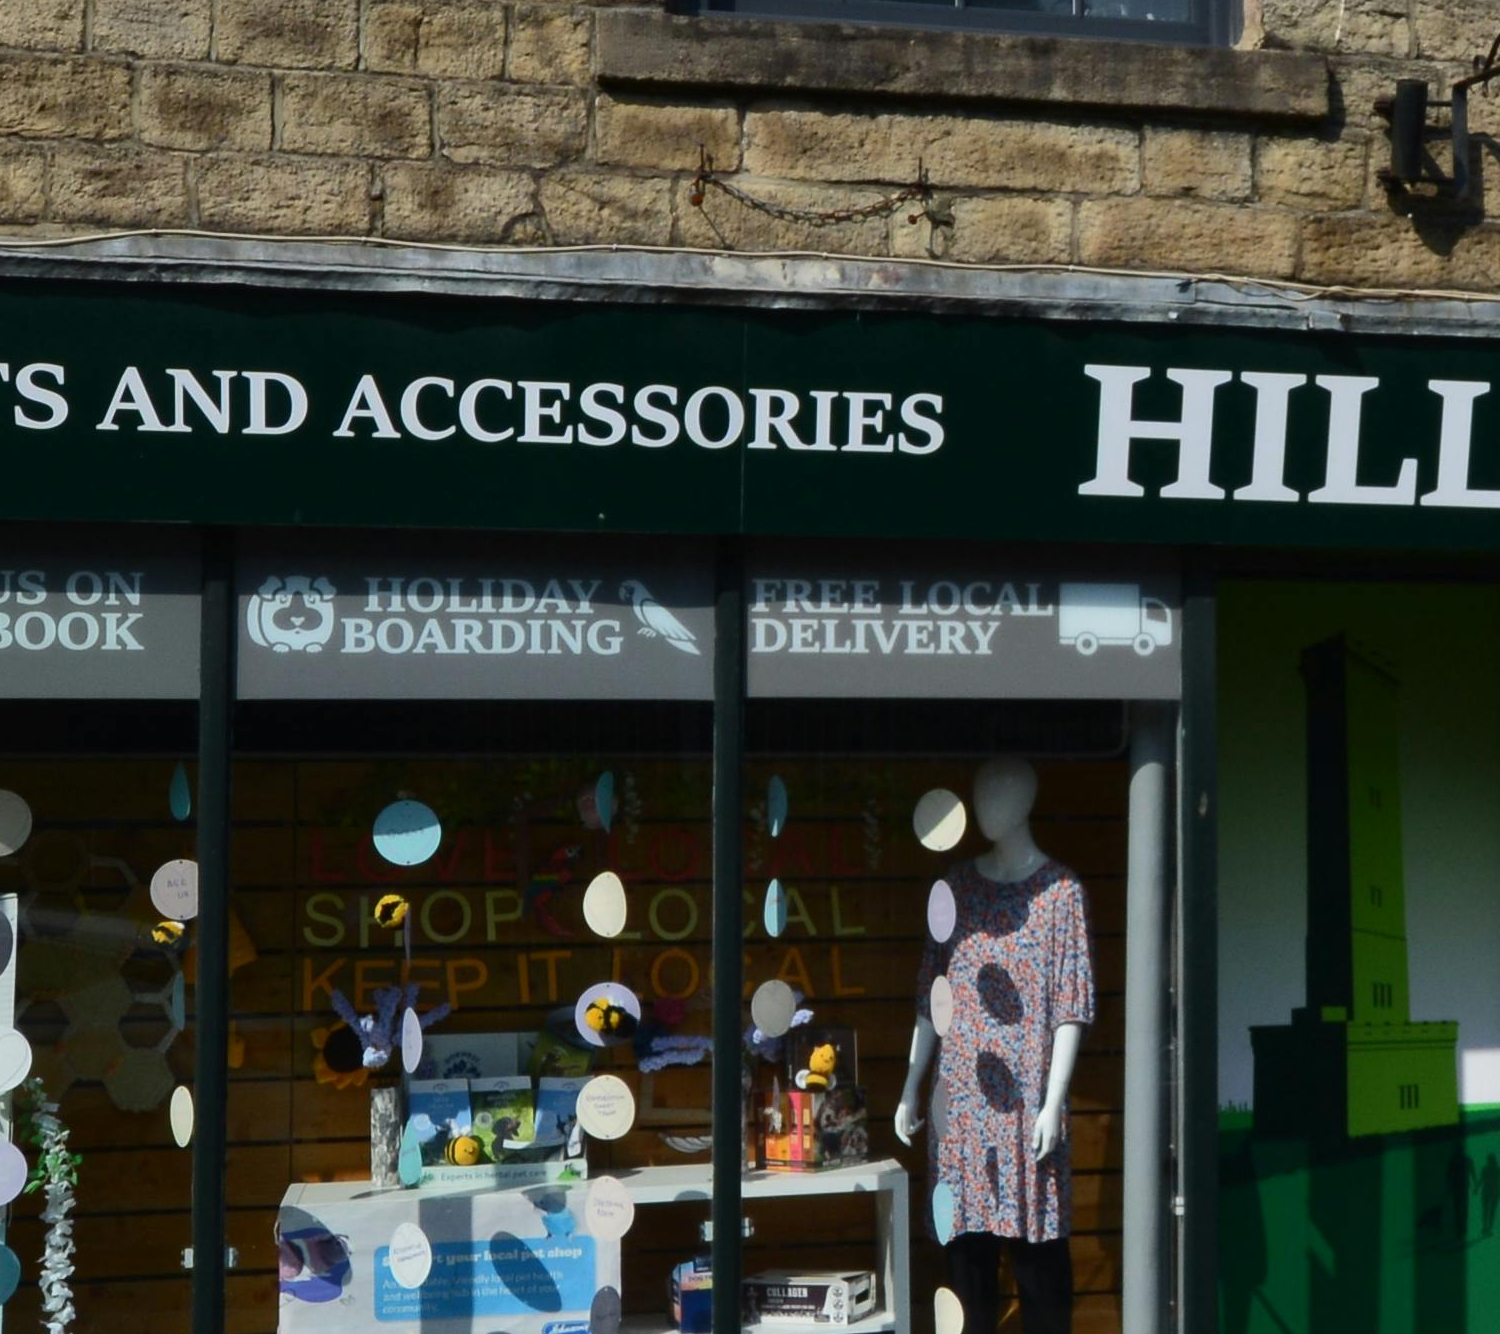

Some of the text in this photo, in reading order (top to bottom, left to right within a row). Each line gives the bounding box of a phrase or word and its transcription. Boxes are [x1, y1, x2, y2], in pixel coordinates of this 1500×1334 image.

[96, 366, 308, 436] AND
[333, 374, 944, 455] ACCESSORIES
[65, 571, 144, 607] ON
[363, 576, 601, 615] HOLIDAY
[752, 579, 1053, 616] FREE LOCAL
[341, 617, 623, 657] BOARDING
[751, 618, 1001, 656] DELIVERY
[516, 950, 572, 1004] IT
[446, 1253, 481, 1266] your
[484, 1249, 519, 1261] local
[521, 1247, 544, 1262] pet
[547, 1246, 582, 1259] shop
